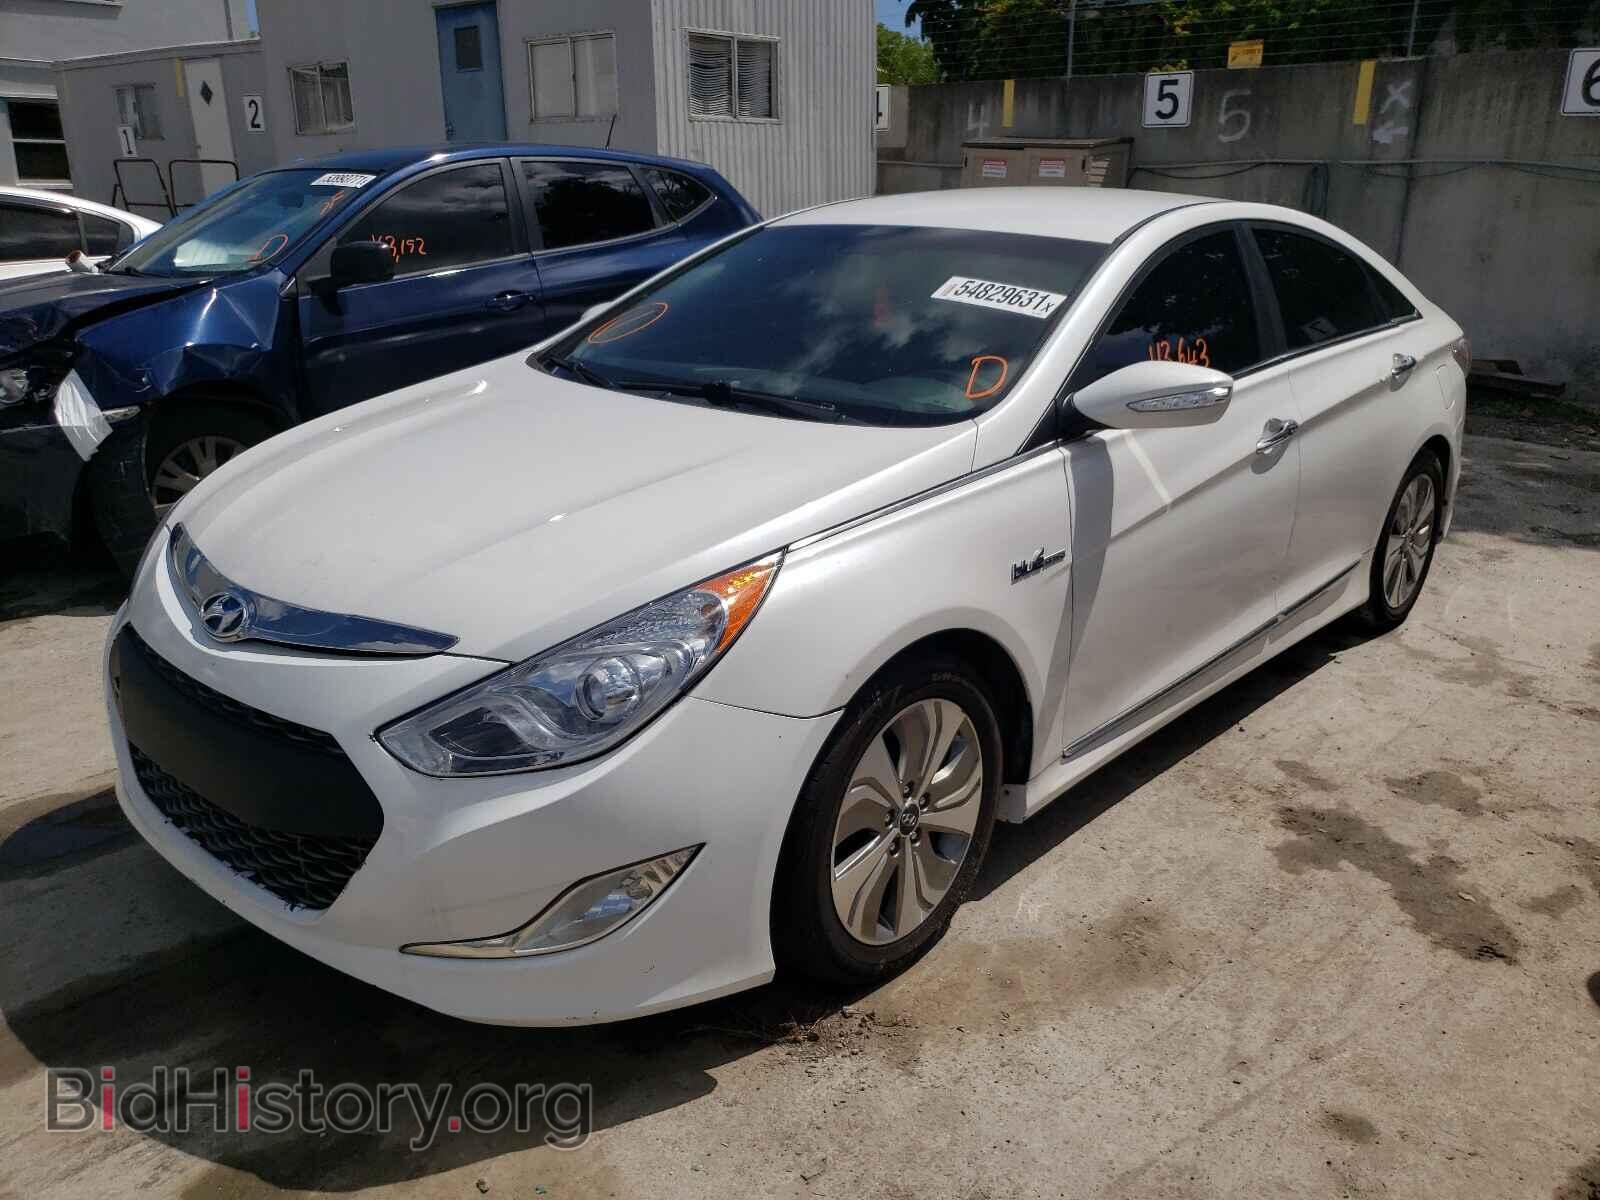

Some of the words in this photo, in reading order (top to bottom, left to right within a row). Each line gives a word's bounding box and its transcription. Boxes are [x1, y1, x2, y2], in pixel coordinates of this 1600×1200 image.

[248, 99, 261, 128] 2
[1155, 79, 1179, 119] 5
[1218, 89, 1251, 142] 5
[122, 129, 133, 155] 1
[964, 355, 1009, 399] D
